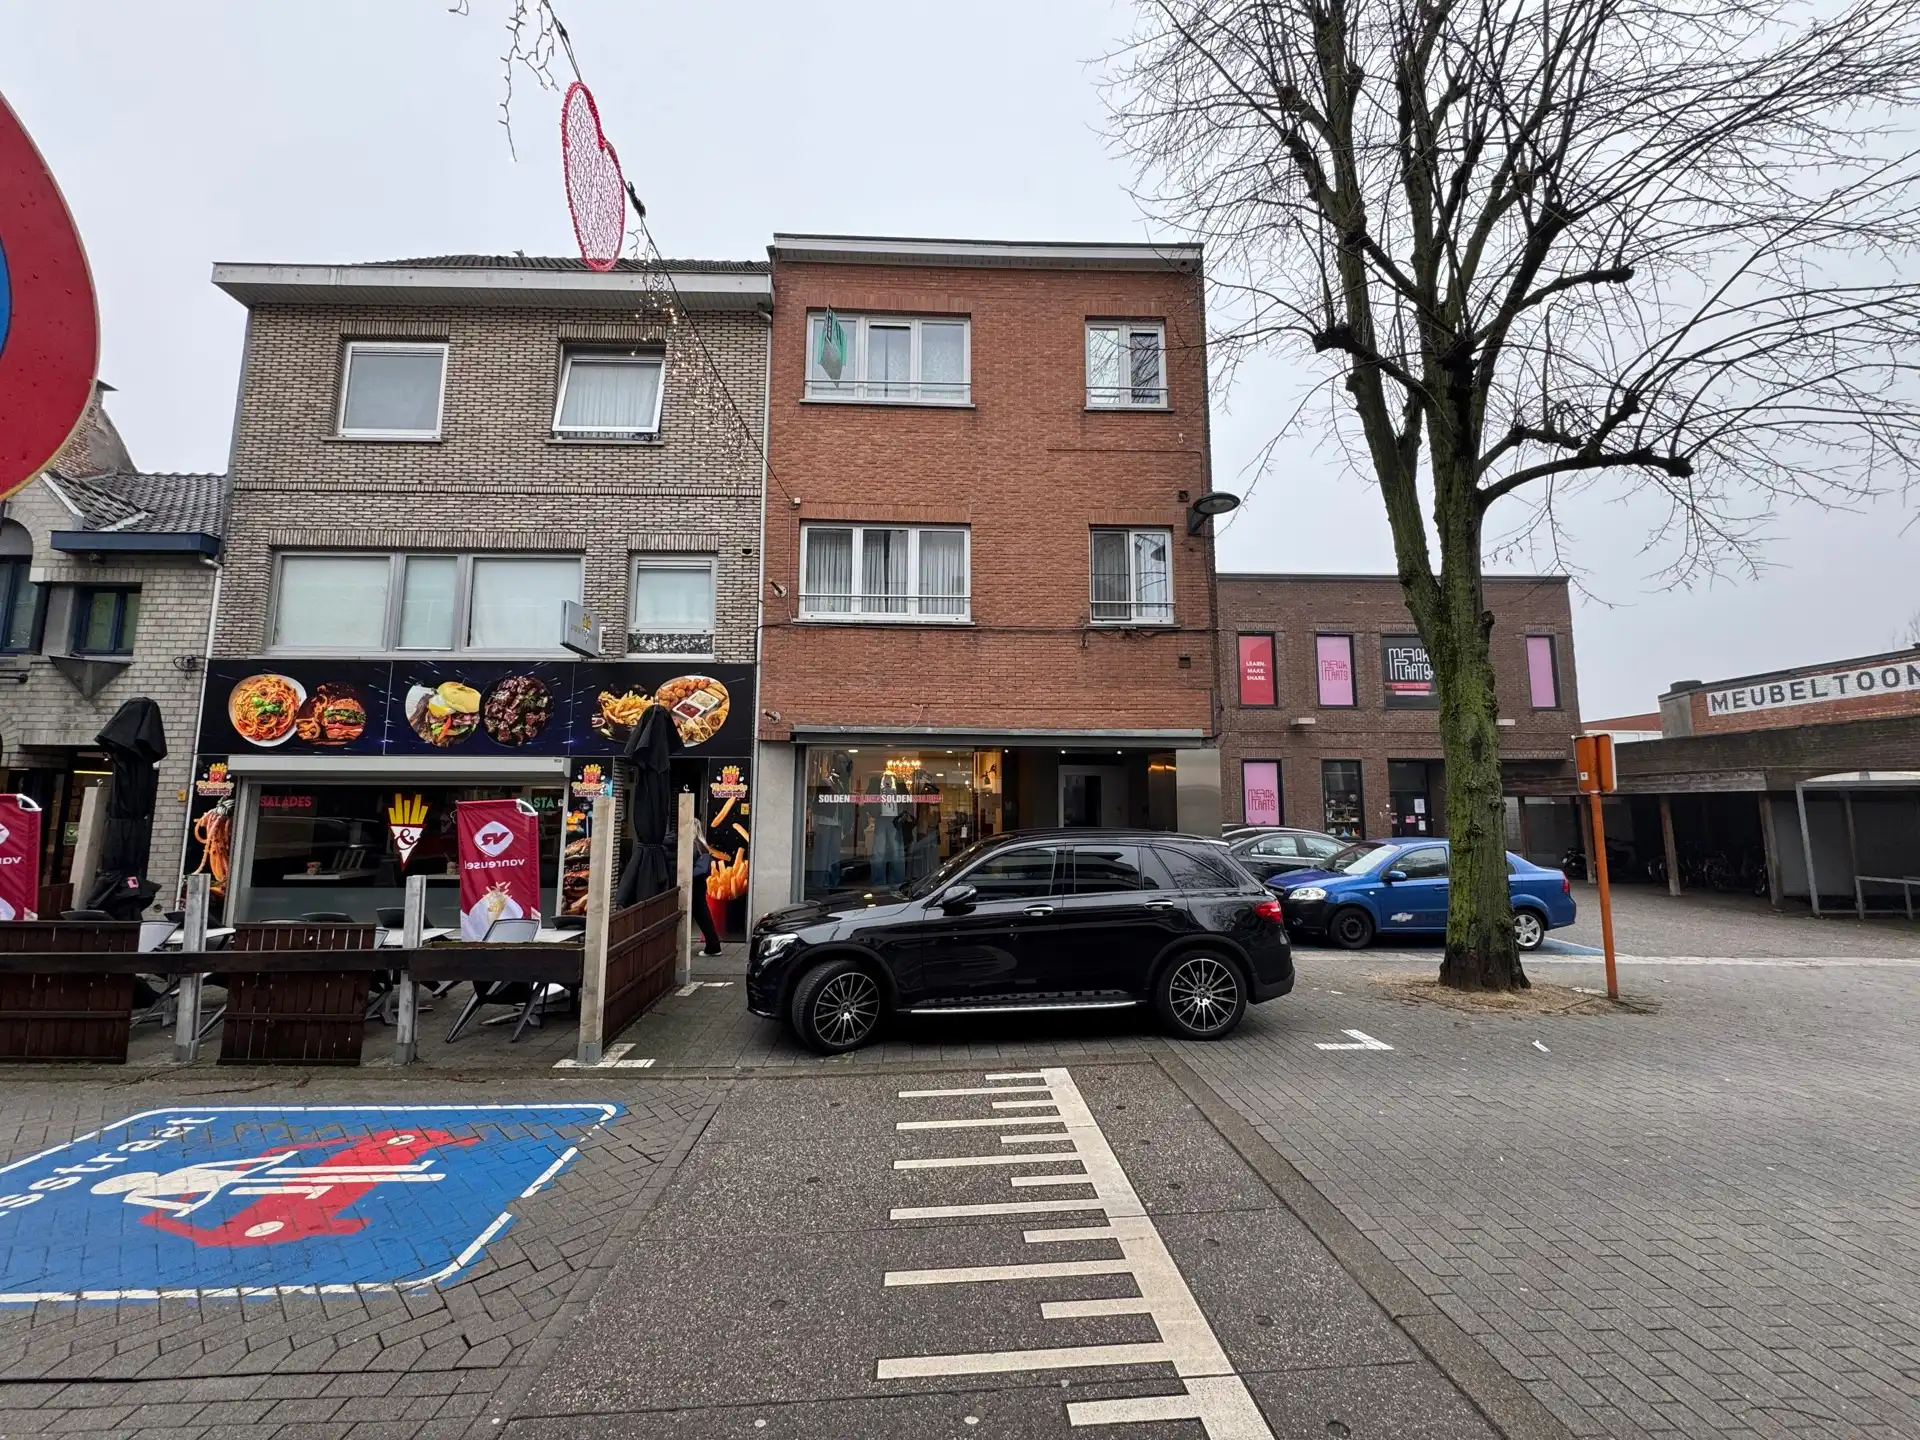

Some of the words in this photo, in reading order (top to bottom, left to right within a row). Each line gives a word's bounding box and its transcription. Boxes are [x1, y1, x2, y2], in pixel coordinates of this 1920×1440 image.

[260, 796, 312, 807] SALADES
[818, 794, 850, 803] SOLDEN
[881, 794, 912, 803] SOLDEN
